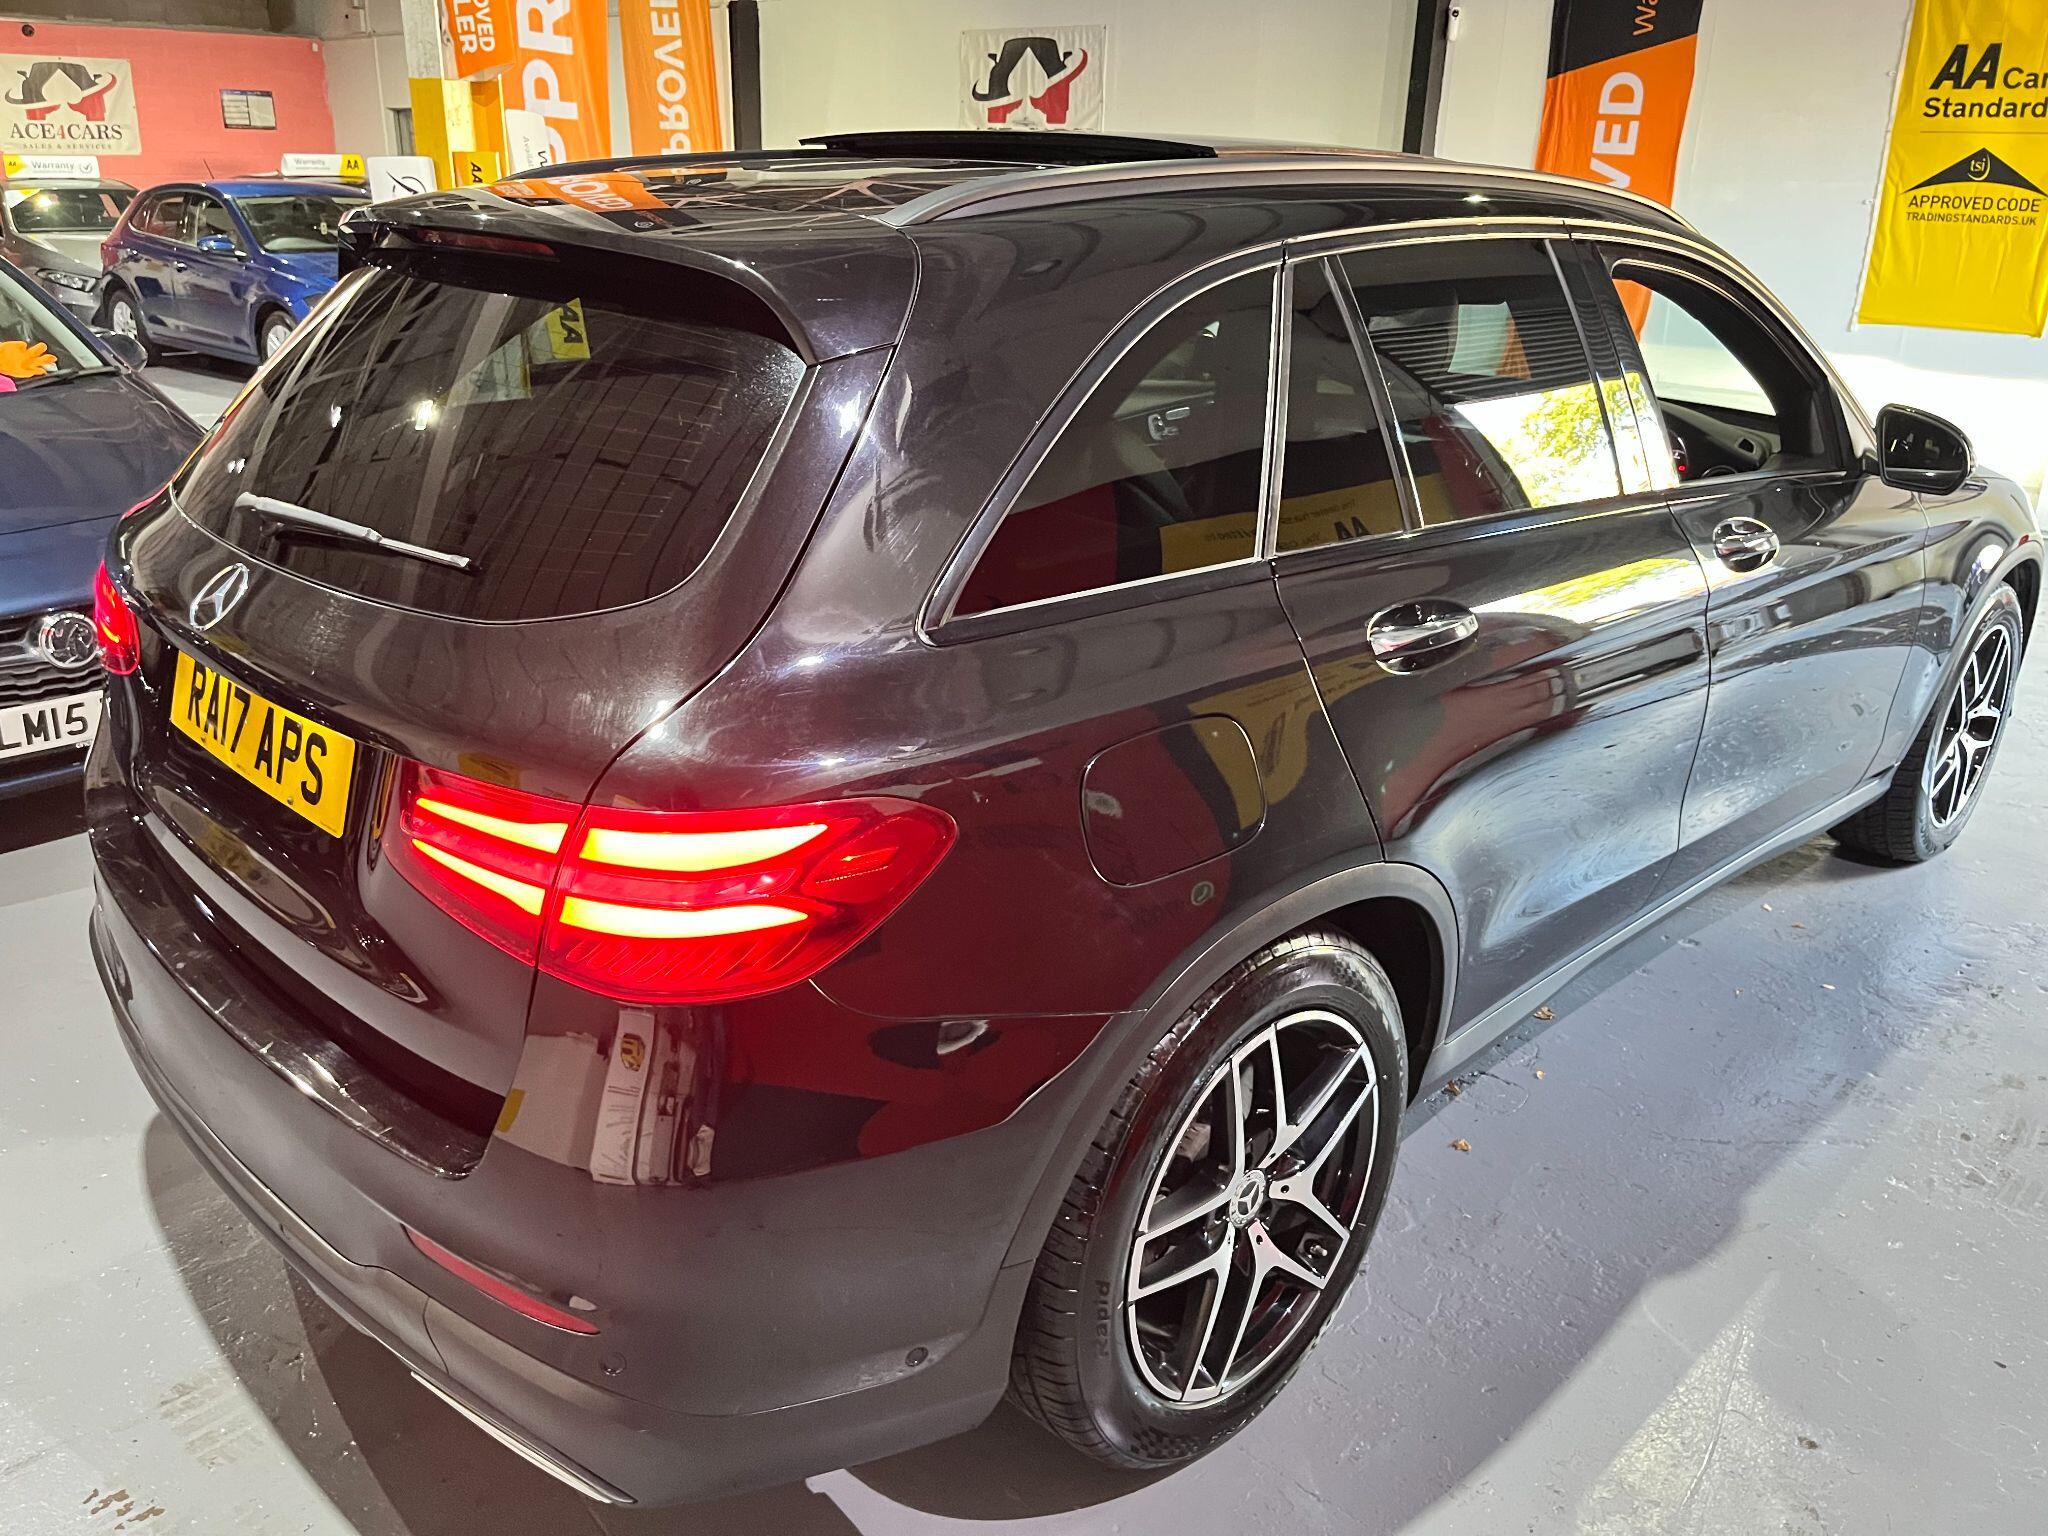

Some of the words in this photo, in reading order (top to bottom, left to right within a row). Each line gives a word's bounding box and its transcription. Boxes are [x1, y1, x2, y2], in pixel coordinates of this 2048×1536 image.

[1929, 43, 2002, 89] AA
[1923, 97, 2048, 118] Standard
[10, 122, 123, 140] ACE4CARS
[31, 160, 75, 170] Warranty
[347, 159, 360, 170] AA
[1970, 158, 1986, 171] tsi
[1908, 195, 1994, 211] APPROVED
[1997, 198, 2042, 213] CODE
[1906, 211, 2038, 226] TRADINGSTANDARDS.UK
[188, 661, 252, 754] RA17
[254, 706, 328, 806] APS
